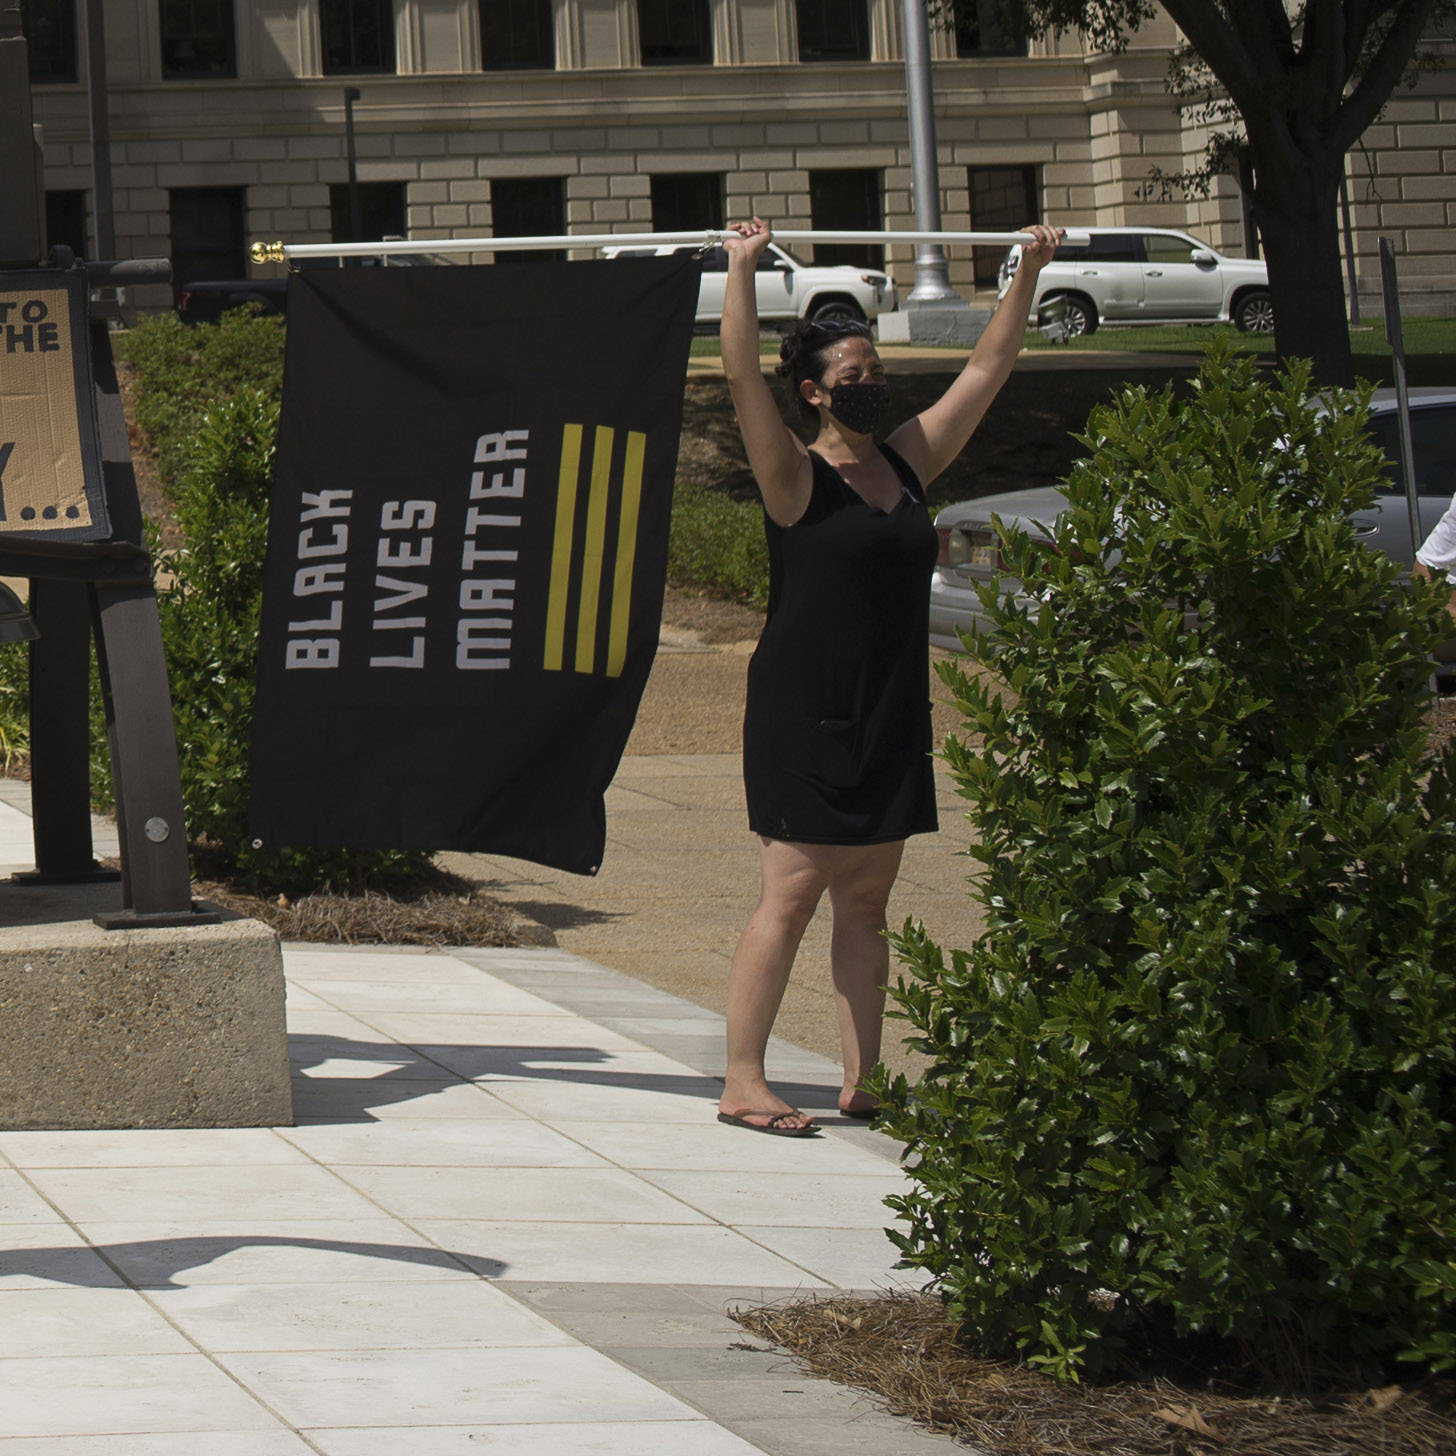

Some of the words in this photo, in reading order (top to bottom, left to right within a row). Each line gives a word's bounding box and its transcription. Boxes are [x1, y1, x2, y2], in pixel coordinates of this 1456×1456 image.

[285, 489, 353, 670] BLACK
[369, 500, 437, 669] LIVES
[456, 429, 529, 670] MATTER
